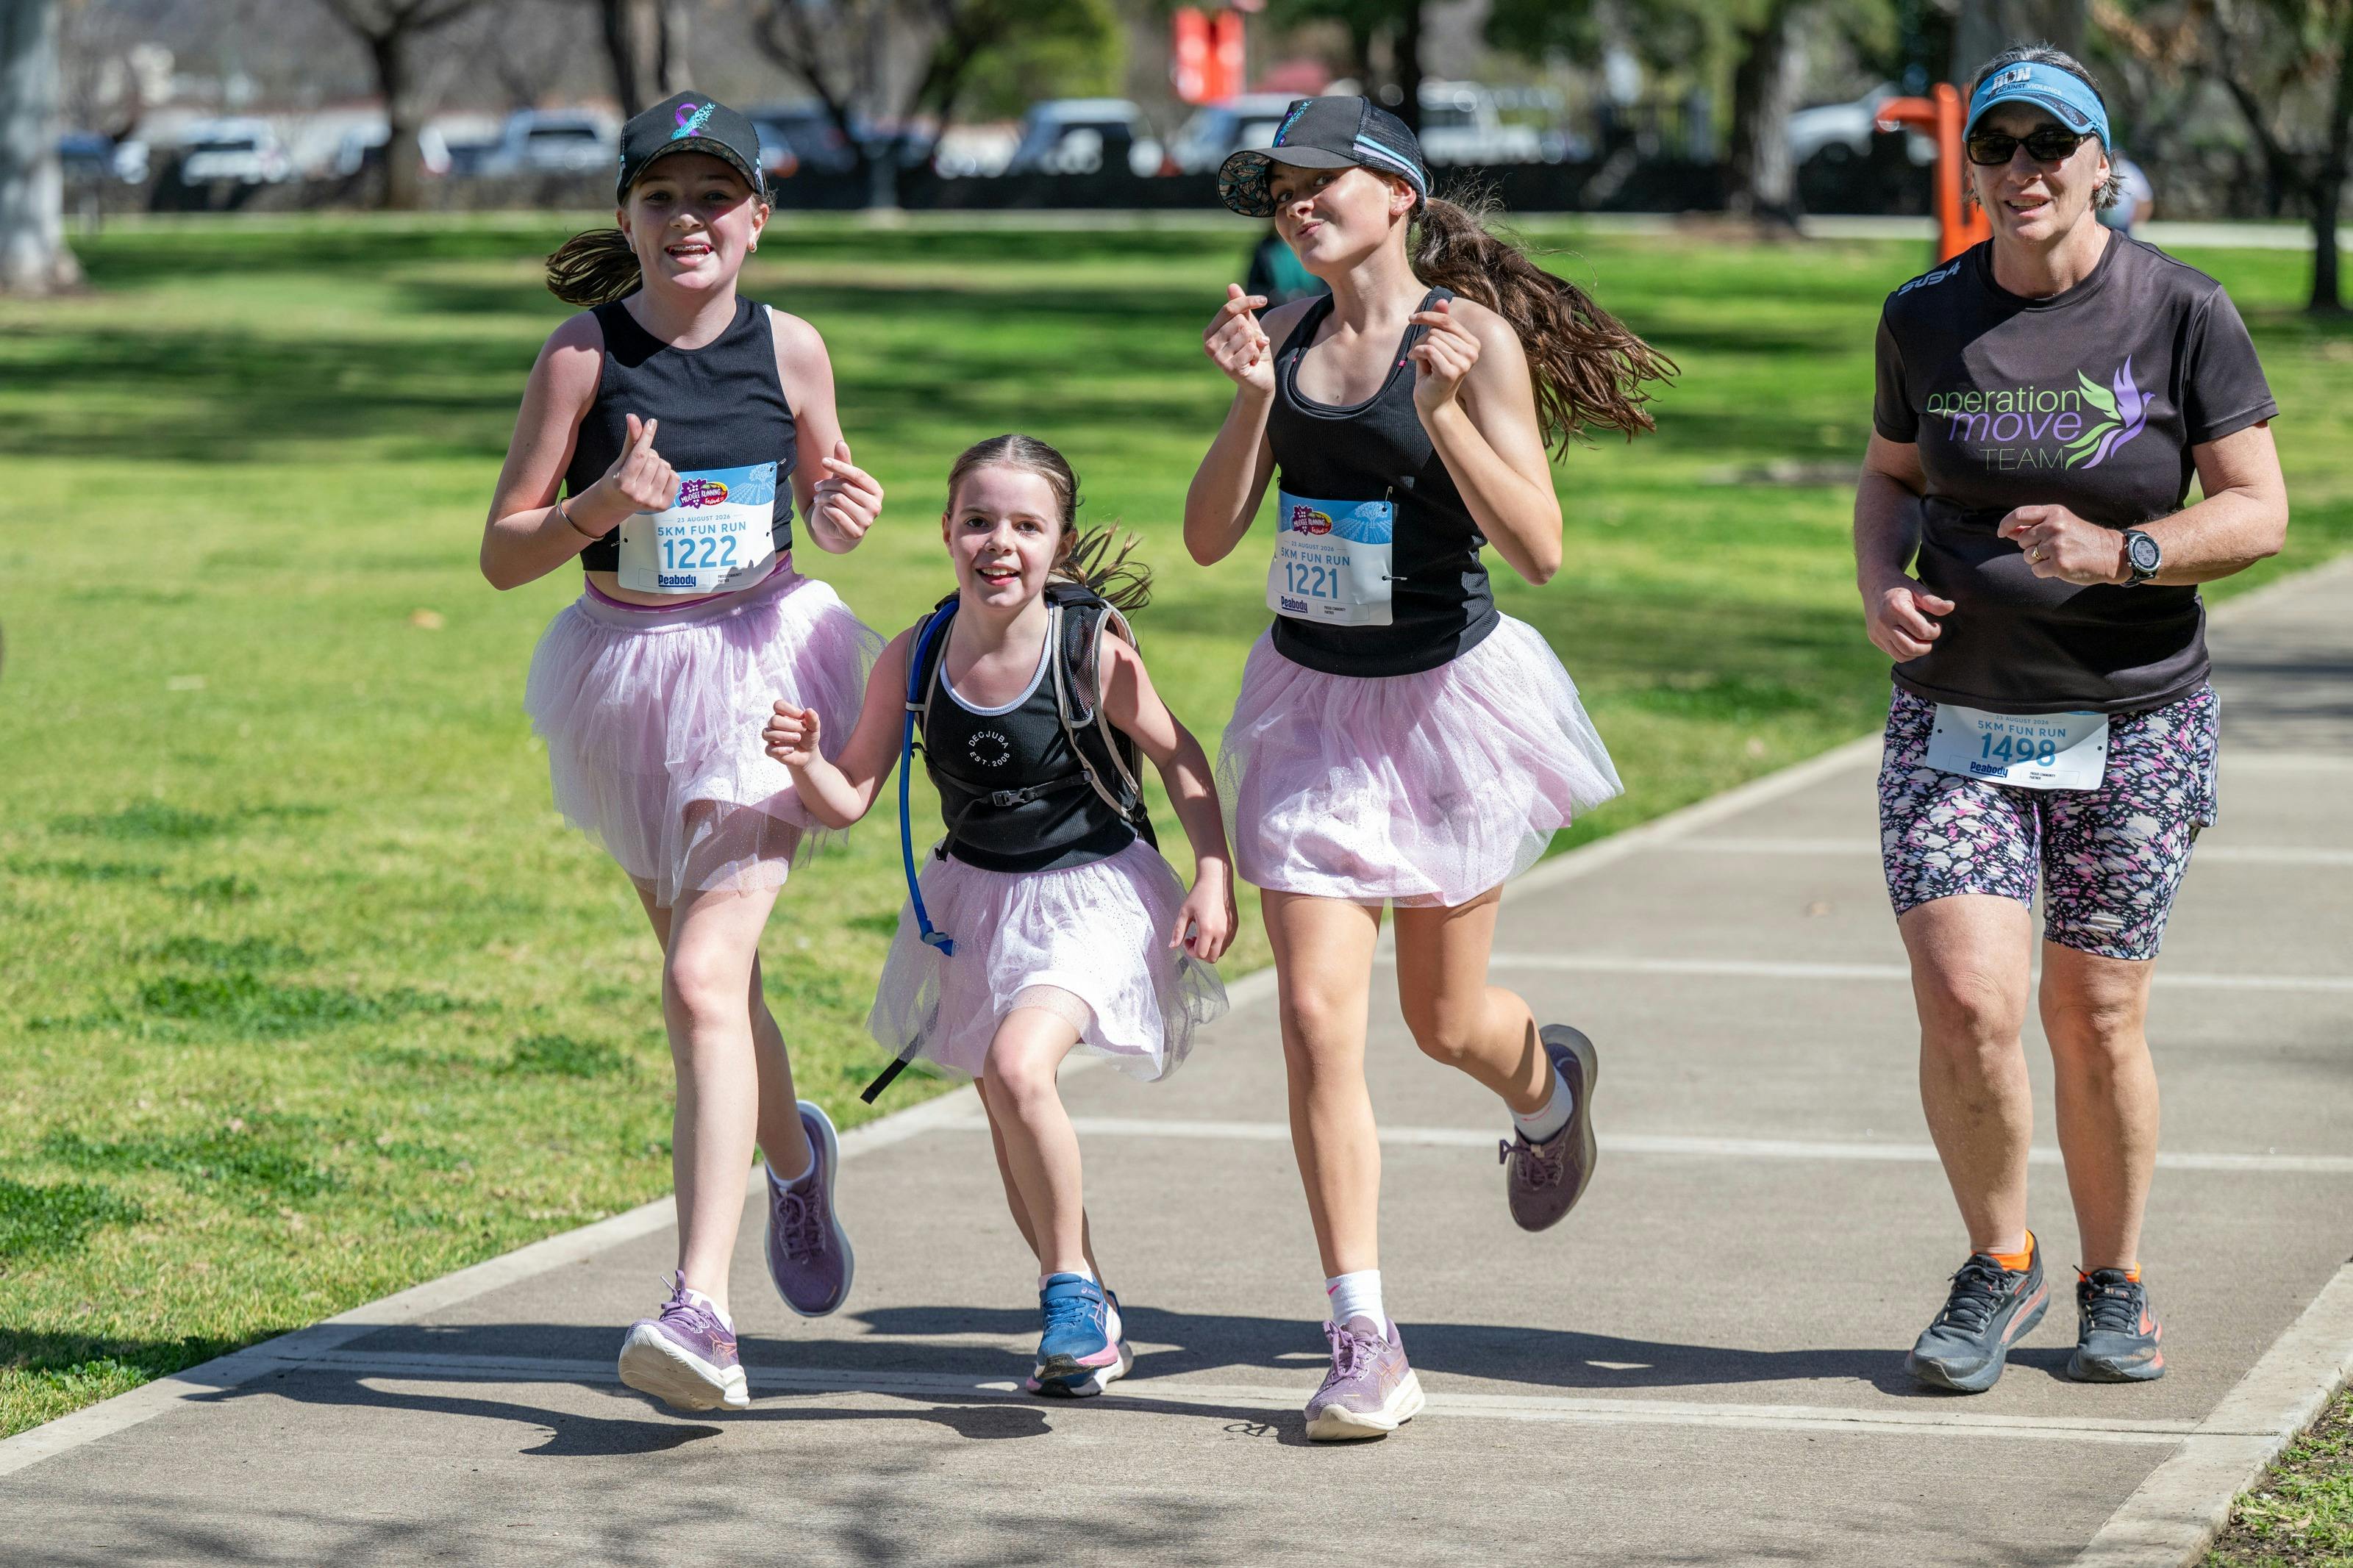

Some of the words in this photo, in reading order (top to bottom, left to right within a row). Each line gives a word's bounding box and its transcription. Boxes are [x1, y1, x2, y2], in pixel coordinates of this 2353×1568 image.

[1998, 83, 2025, 94] AGAINST
[2027, 83, 2062, 96] VIOLENCE
[1927, 385, 2081, 418] operation
[1949, 411, 2082, 442] move
[1978, 447, 2065, 470] TEAM
[681, 492, 700, 504] MUDGEE
[701, 489, 721, 498] RUNNING
[657, 526, 685, 537] 5KM
[690, 524, 715, 535] FUN
[721, 521, 746, 533] RUN
[663, 535, 737, 570] 1222
[1281, 547, 1297, 559] 5KM
[1301, 552, 1321, 563] FUN
[1326, 555, 1350, 566] RUN
[1298, 543, 1318, 551] AUGUST
[658, 574, 696, 587] Peabody
[1285, 562, 1338, 599] 1221
[1281, 595, 1308, 614] Peabody
[1977, 720, 2004, 731] 5KM
[2009, 725, 2033, 736] FUN
[2039, 728, 2066, 737] RUN
[968, 730, 1009, 749] DECJUBA
[1981, 732, 2056, 767] 1498
[1970, 761, 2008, 778] Peabody
